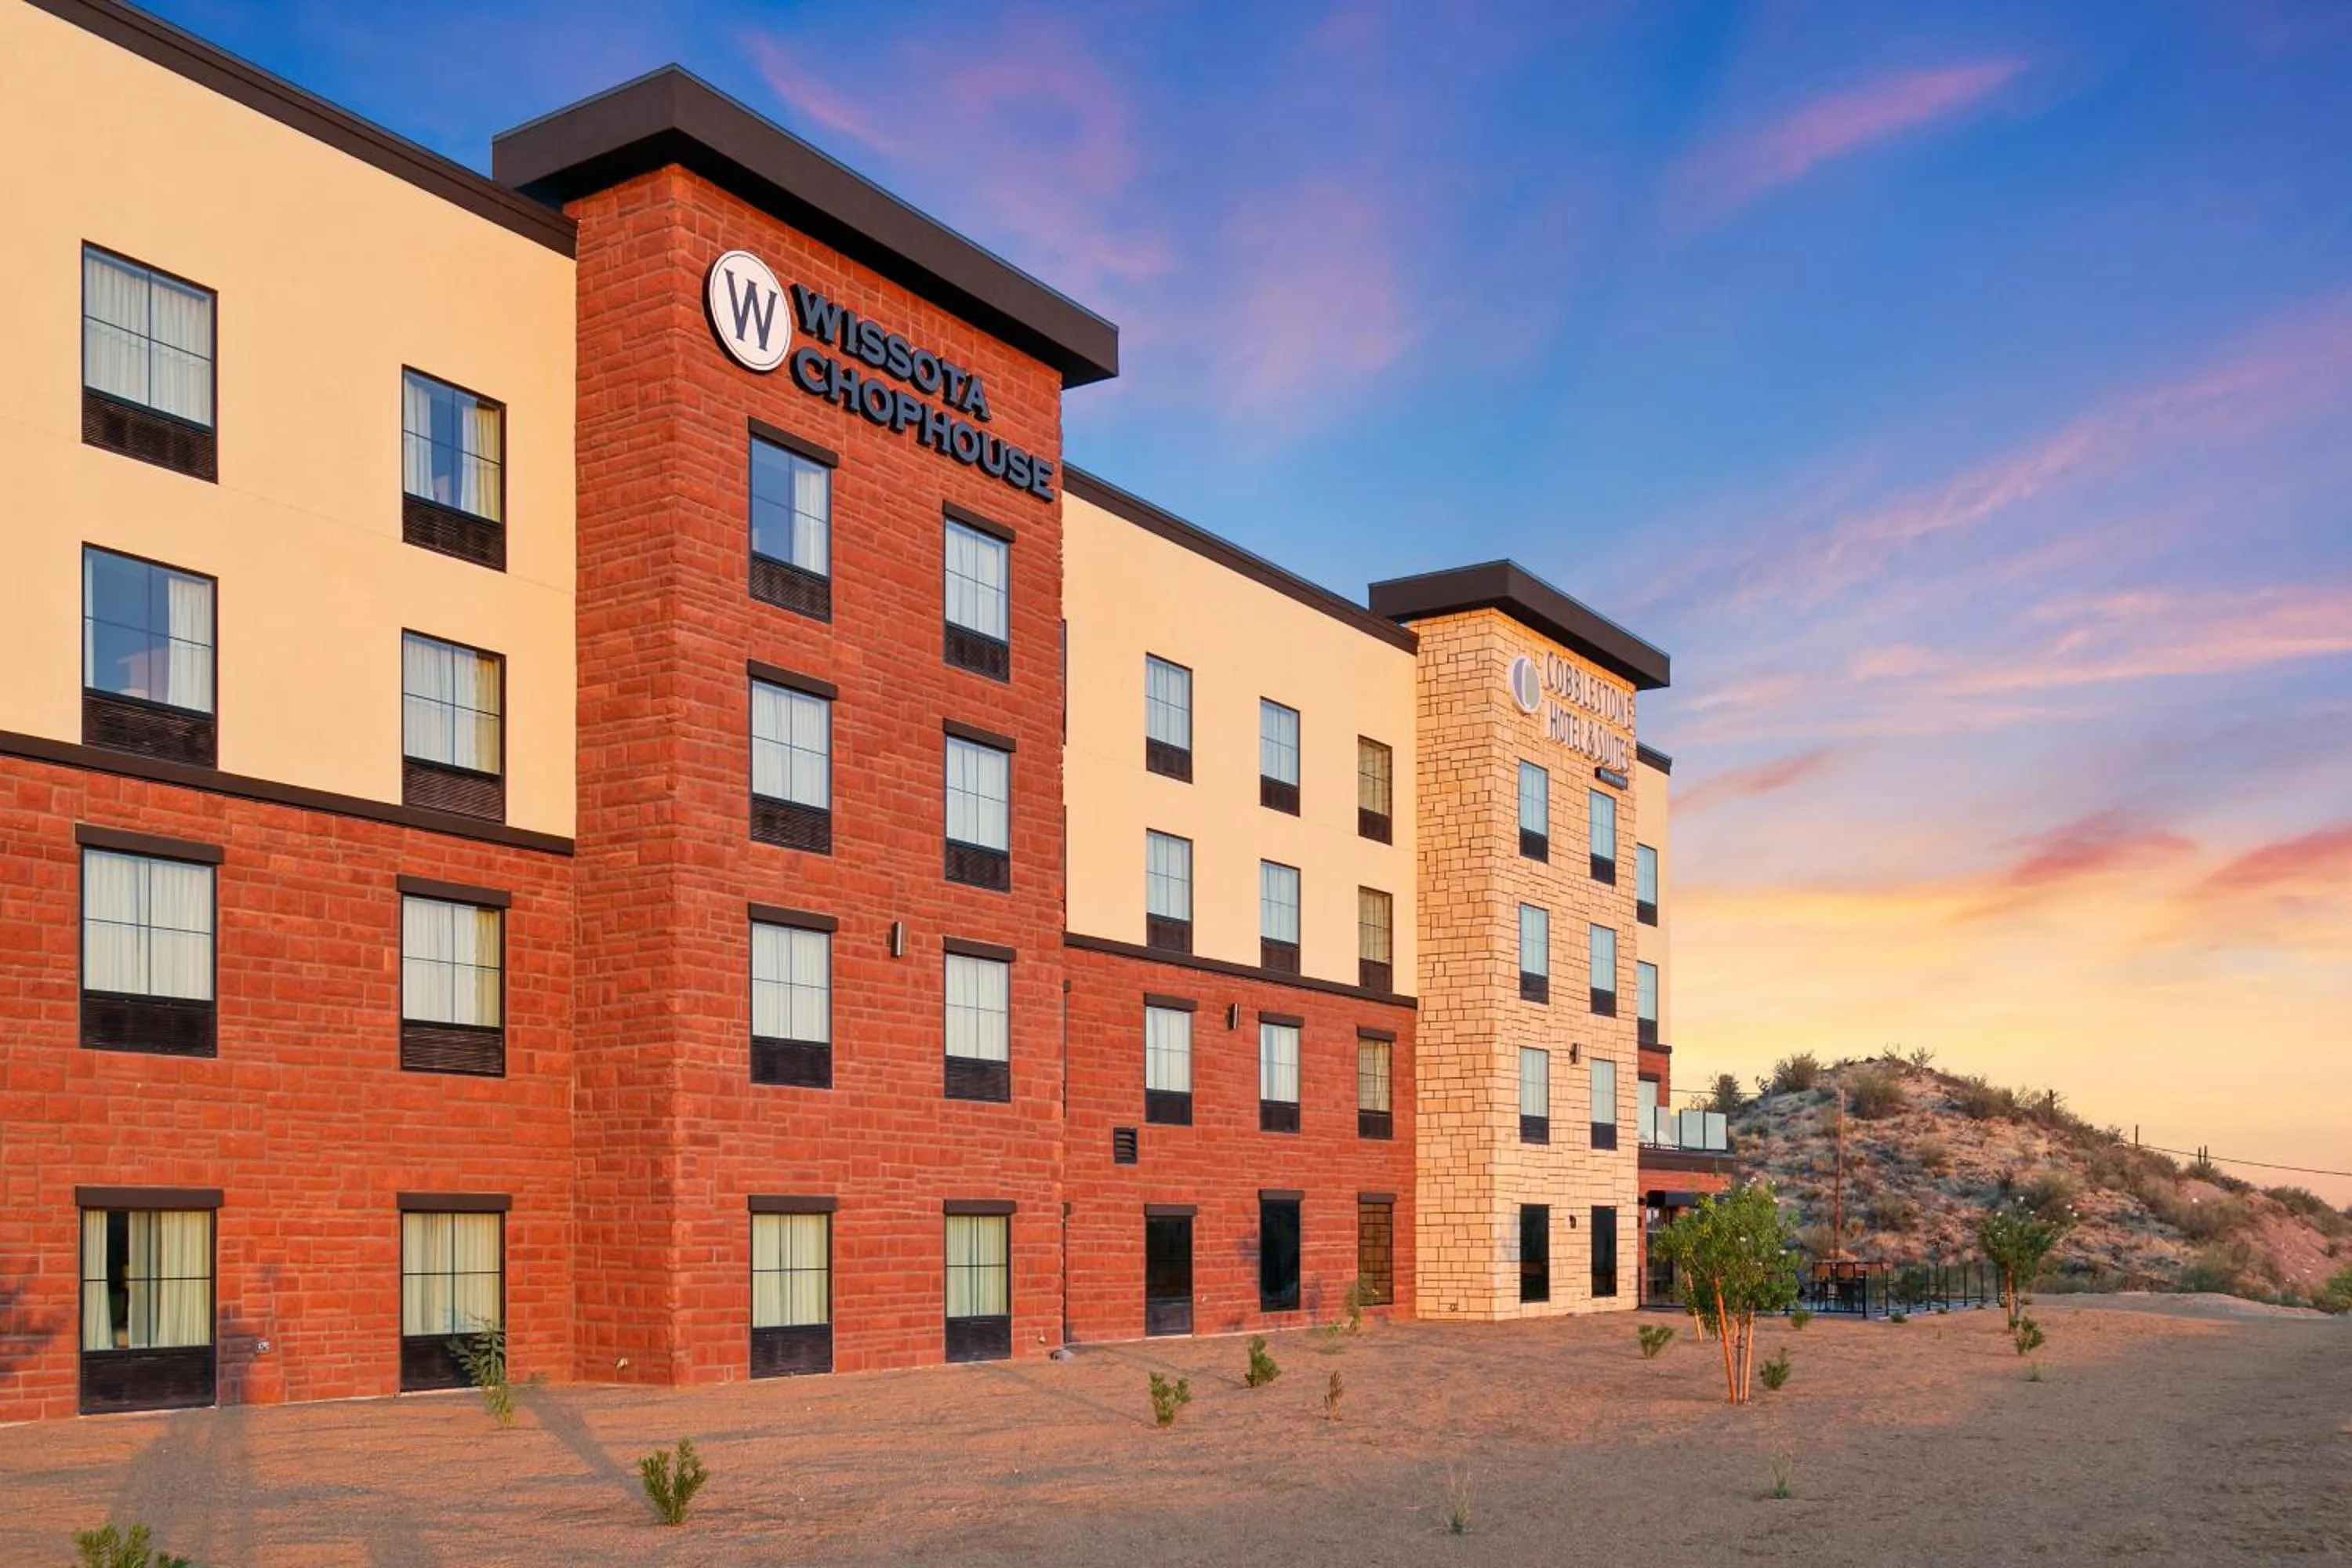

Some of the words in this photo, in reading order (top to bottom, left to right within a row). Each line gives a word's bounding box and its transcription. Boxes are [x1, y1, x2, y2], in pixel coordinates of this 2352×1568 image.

[724, 267, 778, 352] W
[790, 283, 991, 421] WISSOTA
[792, 347, 1054, 503] CHOPHOUSE
[1544, 651, 1632, 730] COBBLESTONE
[1545, 699, 1584, 753] HOTEL
